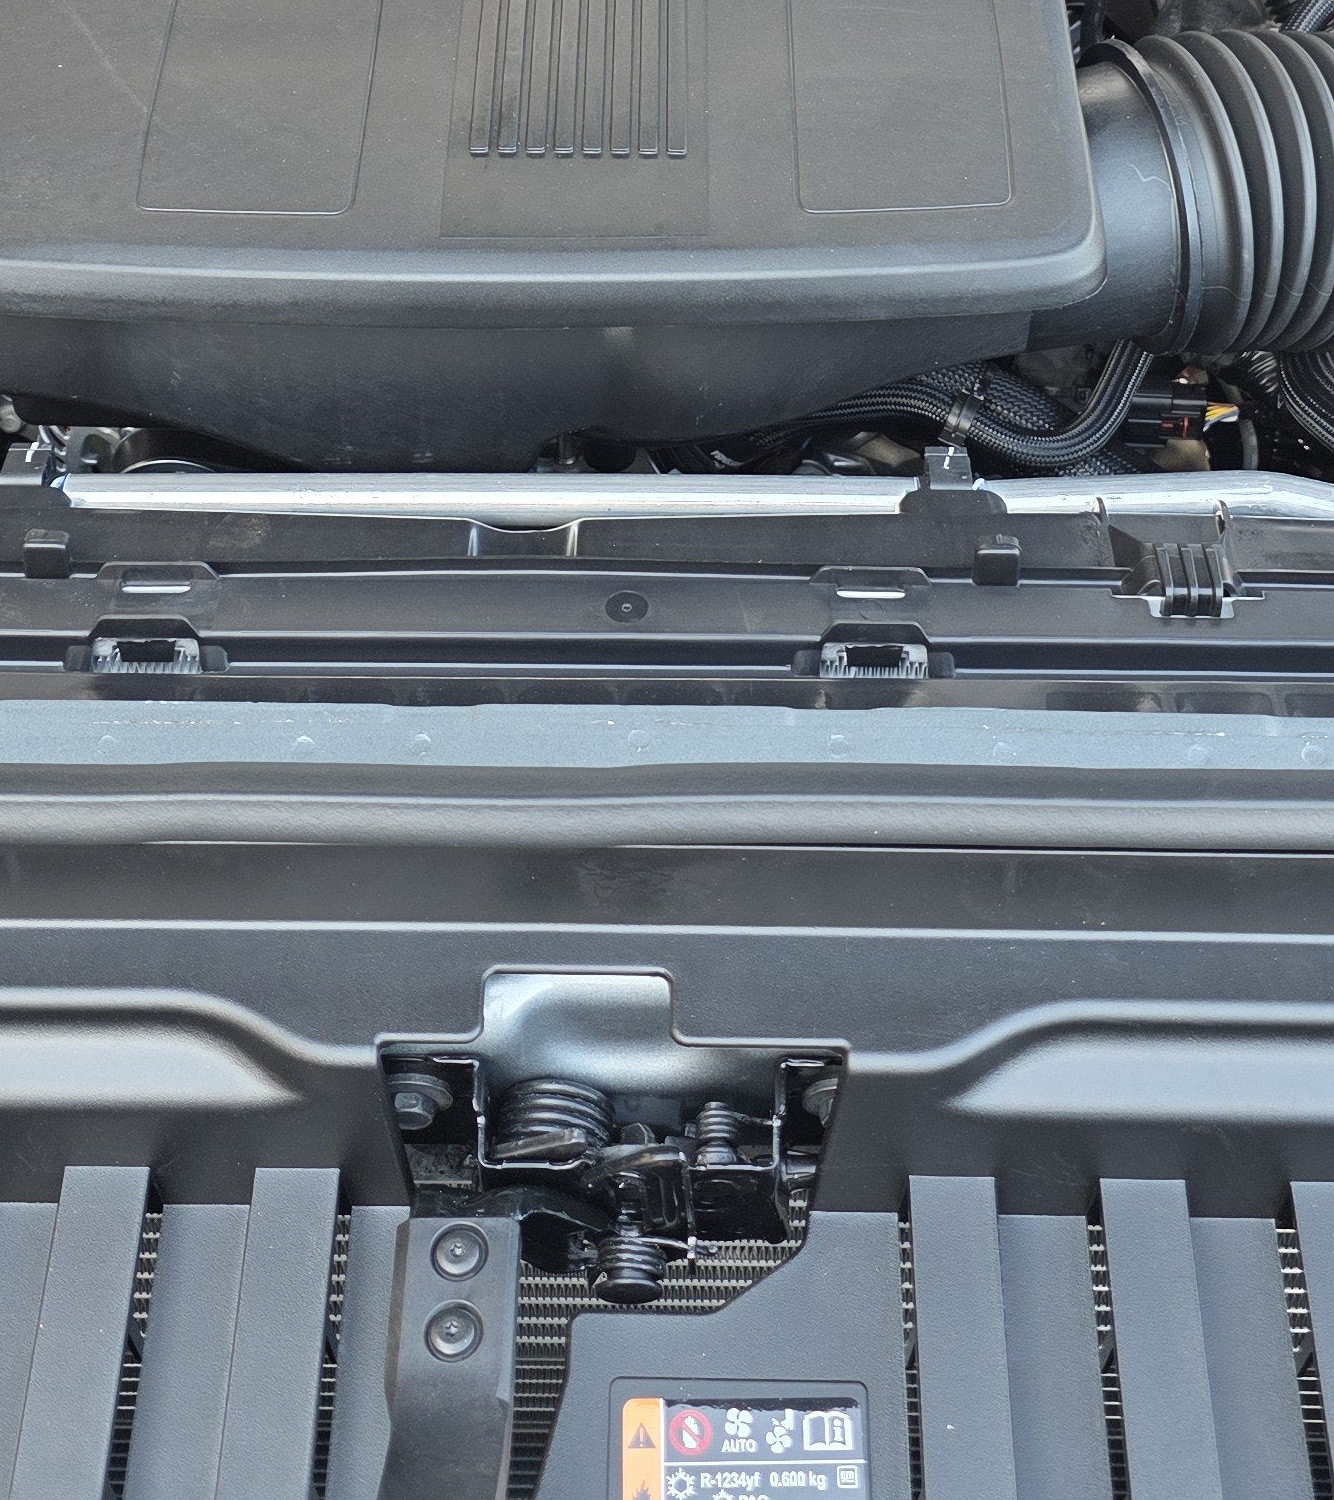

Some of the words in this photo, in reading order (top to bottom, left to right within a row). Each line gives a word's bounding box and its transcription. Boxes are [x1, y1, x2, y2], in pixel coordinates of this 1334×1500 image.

[721, 1438, 756, 1453] AUTO
[700, 1471, 761, 1491] R-1234yf
[769, 1471, 806, 1488] 0.600
[809, 1470, 828, 1491] kg
